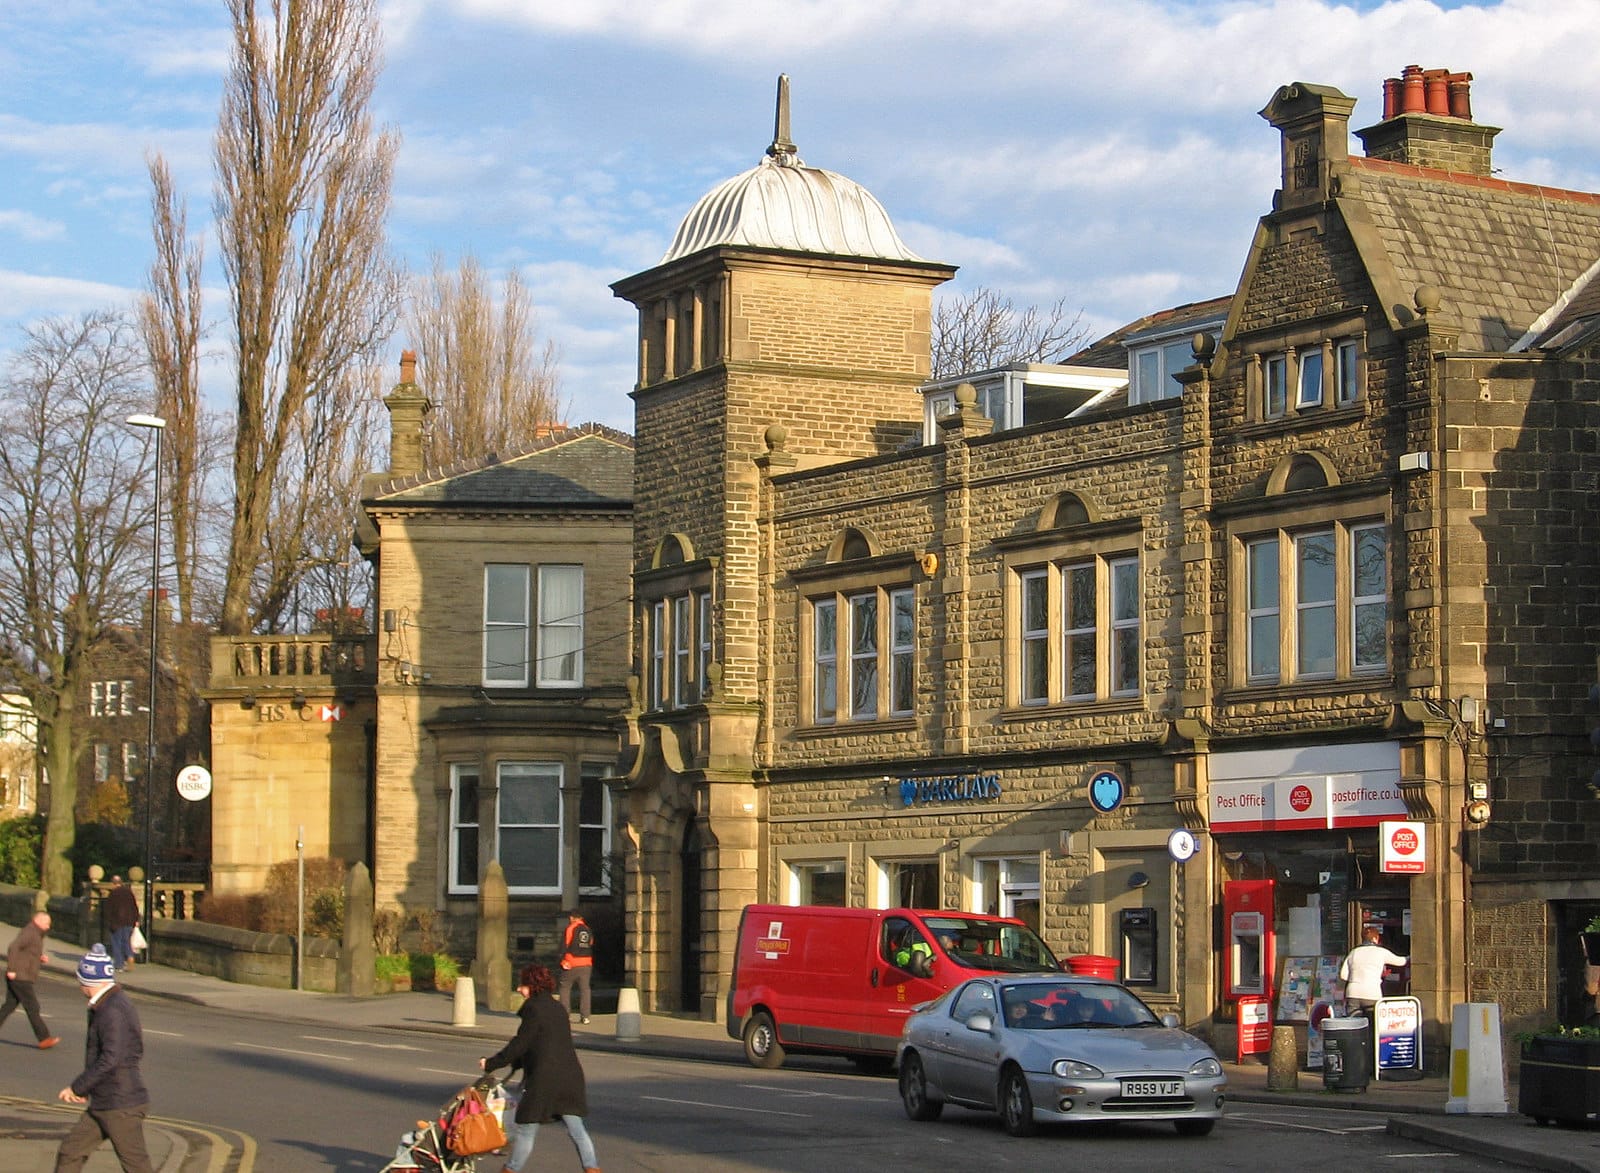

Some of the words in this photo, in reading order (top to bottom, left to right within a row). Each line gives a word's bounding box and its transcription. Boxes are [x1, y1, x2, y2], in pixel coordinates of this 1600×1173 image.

[255, 704, 313, 722] HSC
[181, 782, 208, 791] HSBC
[921, 775, 1002, 801] BARCLAYS
[1294, 790, 1308, 798] POST
[1332, 787, 1402, 803] postoffice.co.u
[1217, 795, 1237, 808] Post
[1240, 794, 1266, 807] Office
[1292, 798, 1311, 806] OFFICE
[1397, 833, 1414, 841] POST
[1393, 841, 1417, 849] OFFICE
[1388, 1006, 1416, 1017] PHOTOS
[1388, 1020, 1407, 1030] Here
[1127, 1083, 1157, 1095] R959
[1160, 1083, 1181, 1095] VJF
